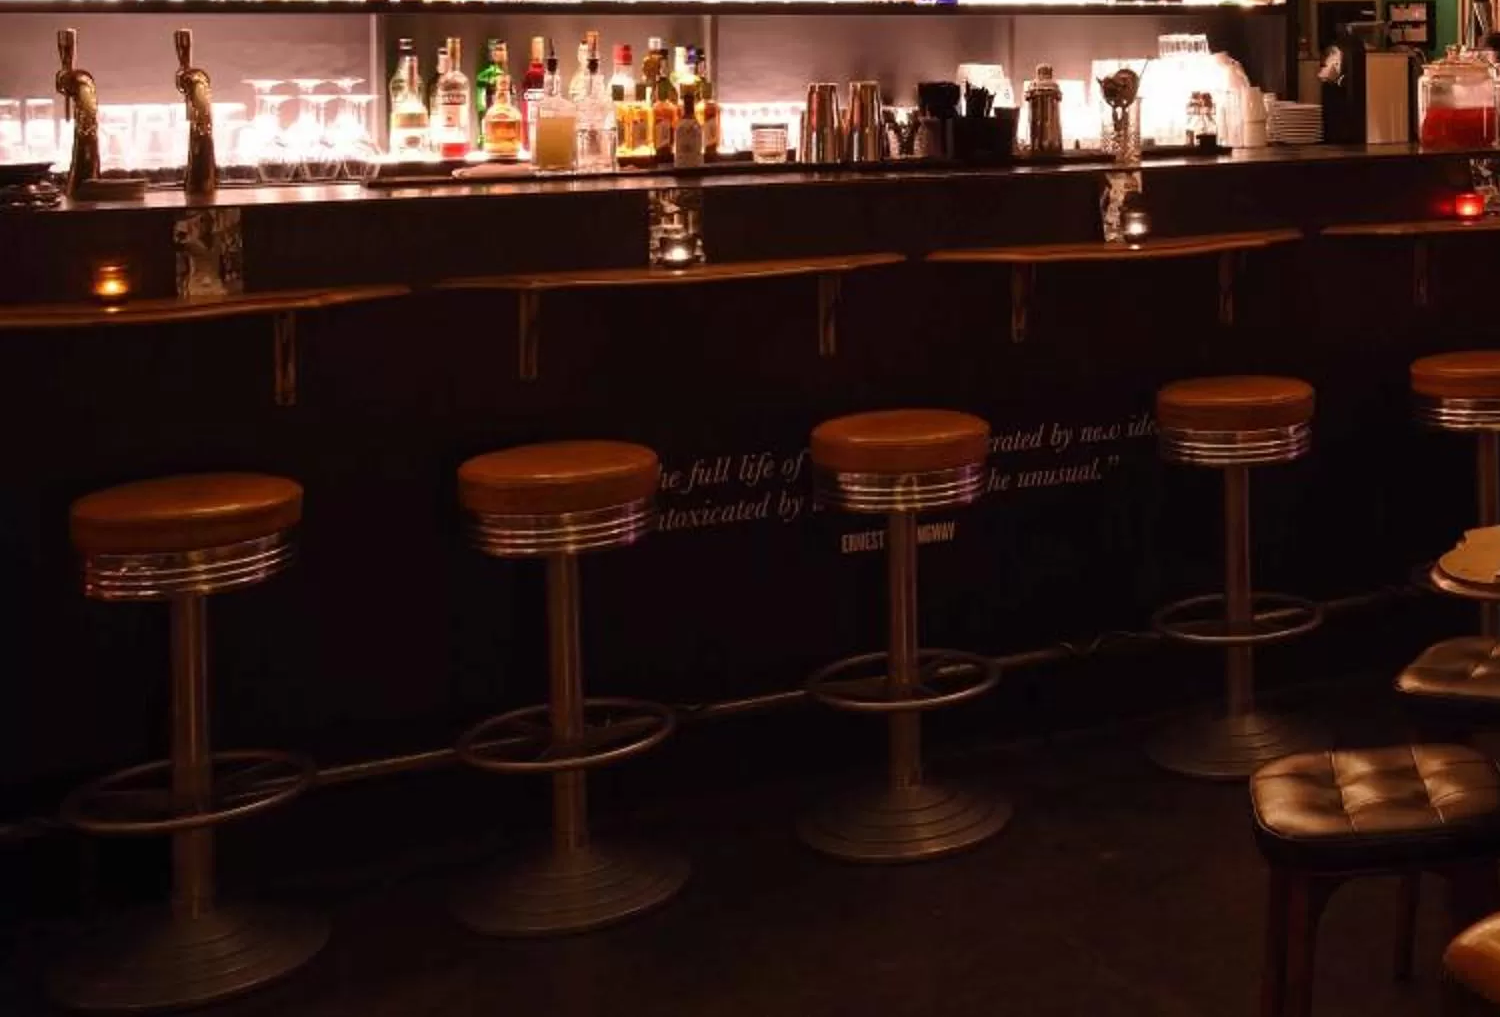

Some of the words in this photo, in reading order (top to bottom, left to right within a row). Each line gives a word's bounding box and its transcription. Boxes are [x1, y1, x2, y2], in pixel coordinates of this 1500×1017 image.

[657, 461, 682, 492] he
[680, 454, 732, 496] full
[738, 450, 776, 488] life
[780, 447, 812, 484] of
[1049, 422, 1074, 453] by
[777, 488, 806, 524] by
[987, 467, 1012, 494] he
[840, 529, 885, 554] ERNEST
[917, 520, 957, 545] NGWAY
